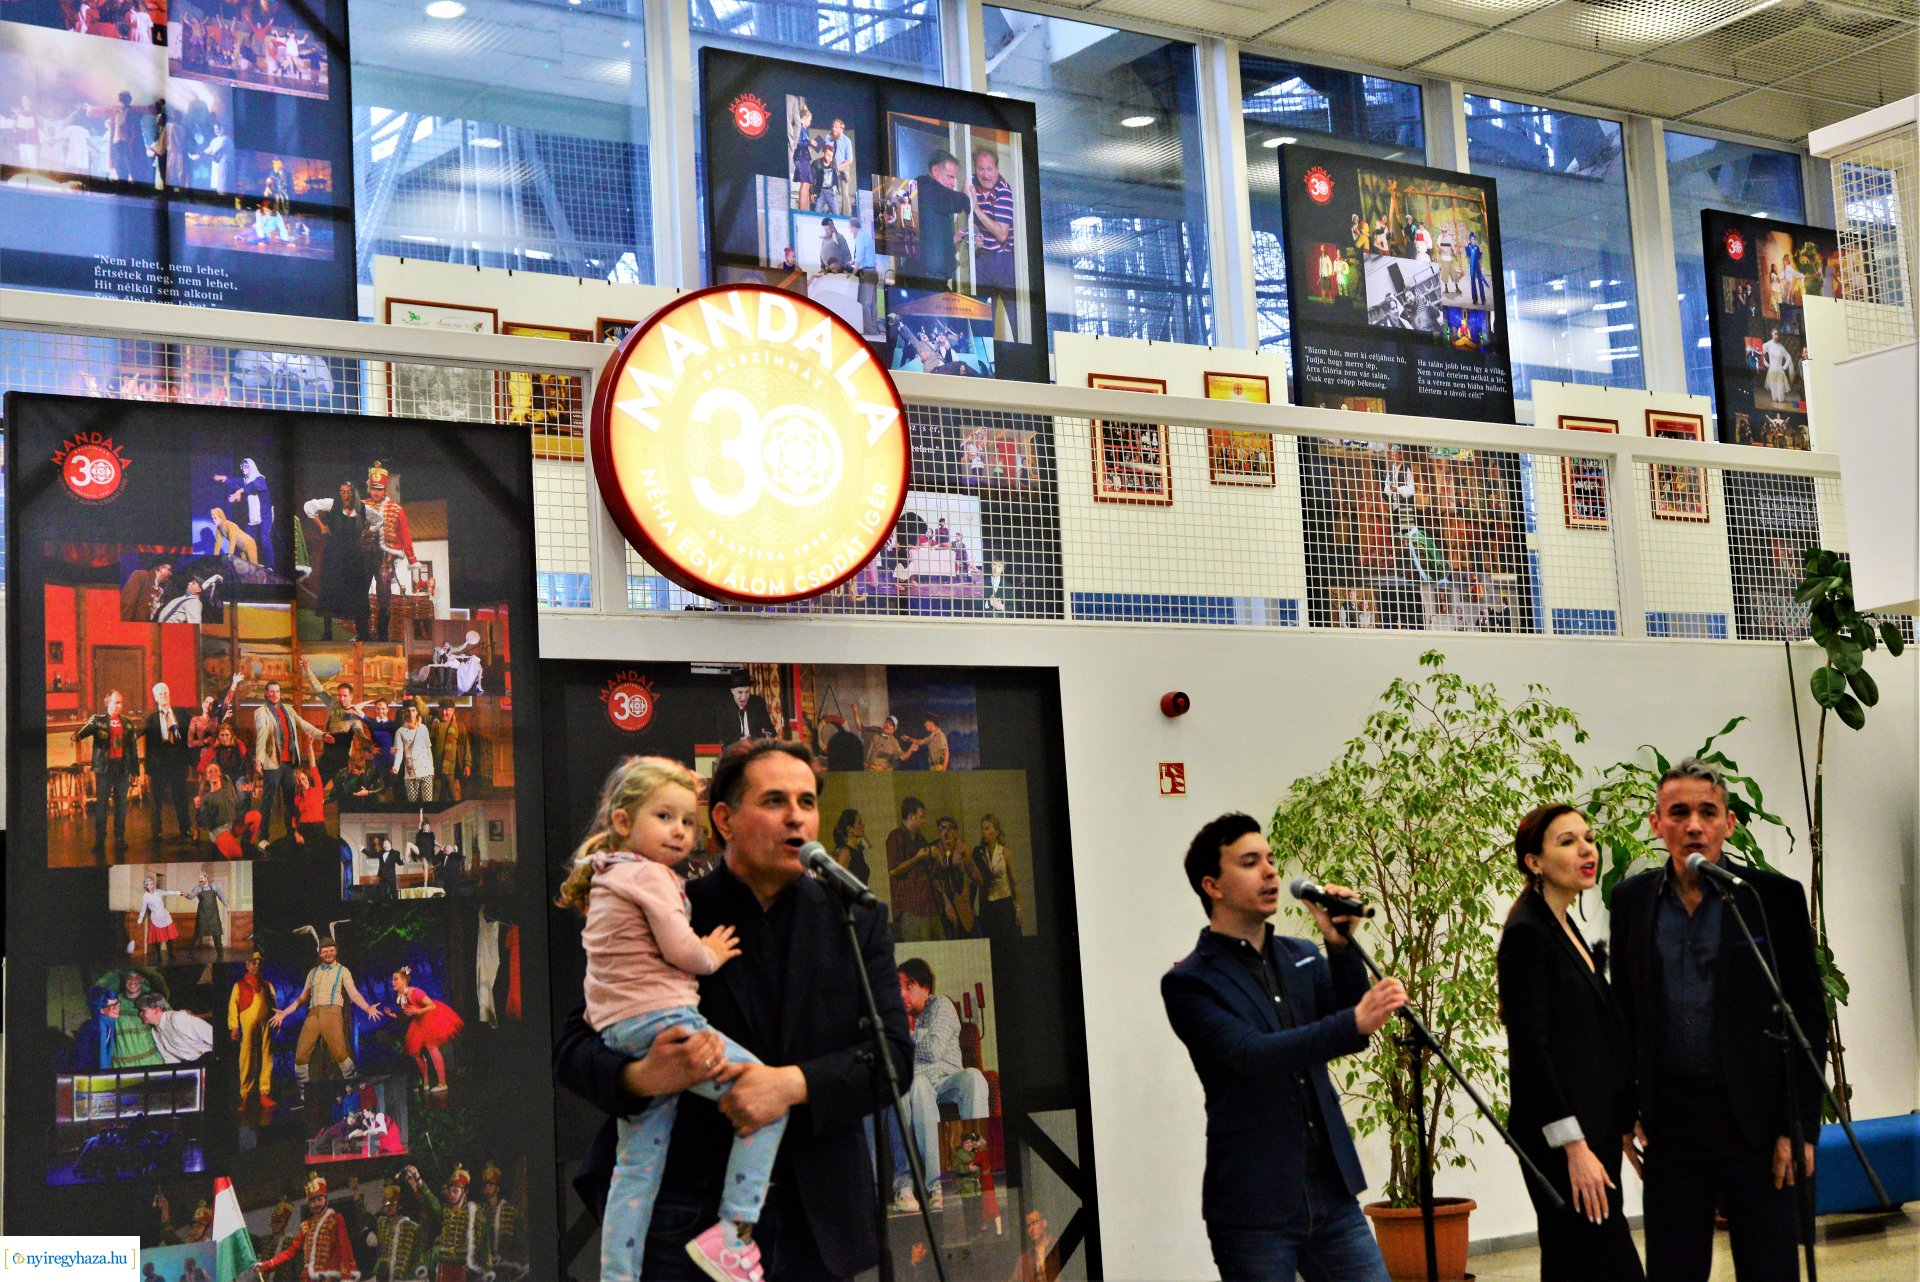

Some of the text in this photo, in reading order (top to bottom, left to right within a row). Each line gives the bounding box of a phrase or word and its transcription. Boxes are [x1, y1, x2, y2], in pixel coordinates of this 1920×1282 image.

[728, 93, 772, 119] MANDALA
[738, 106, 763, 128] 30
[1303, 166, 1335, 187] MANDALA
[1311, 178, 1329, 196] 30
[1728, 238, 1743, 254] 30
[94, 265, 142, 281] Értsétek
[178, 277, 202, 287] nem
[168, 263, 192, 273] nem
[94, 279, 112, 290] Hit
[157, 287, 180, 297] sem
[184, 288, 223, 301] alkotni
[1327, 357, 1343, 367] hogy
[1345, 360, 1364, 368] merre
[1344, 350, 1359, 359] mert
[1360, 351, 1367, 360] ki
[1417, 358, 1426, 367] Ha
[1428, 360, 1444, 369] talán
[1445, 361, 1459, 370] jobb
[1460, 363, 1472, 371] lesz
[614, 291, 900, 447] MANDALA
[1305, 364, 1320, 373] Arra
[1322, 366, 1342, 375] Glória
[1344, 369, 1358, 377] nem
[1359, 370, 1370, 378] vár
[1306, 373, 1322, 382] Csak
[1323, 377, 1335, 385] egy
[1417, 367, 1431, 376] Nem
[1433, 369, 1445, 378] volt
[1446, 370, 1469, 380] értelem
[1417, 376, 1425, 384] És
[1432, 379, 1451, 387] vérem
[1418, 386, 1442, 395] Elértem
[1449, 389, 1467, 398] távoli
[51, 431, 133, 470] MANDALA
[690, 387, 844, 515] 30
[70, 455, 115, 487] 30
[640, 468, 889, 597] NÉHA EGY ÁLOM CSODÁT ÍGÉR
[598, 670, 661, 703] MANDALA
[613, 692, 648, 721] 30
